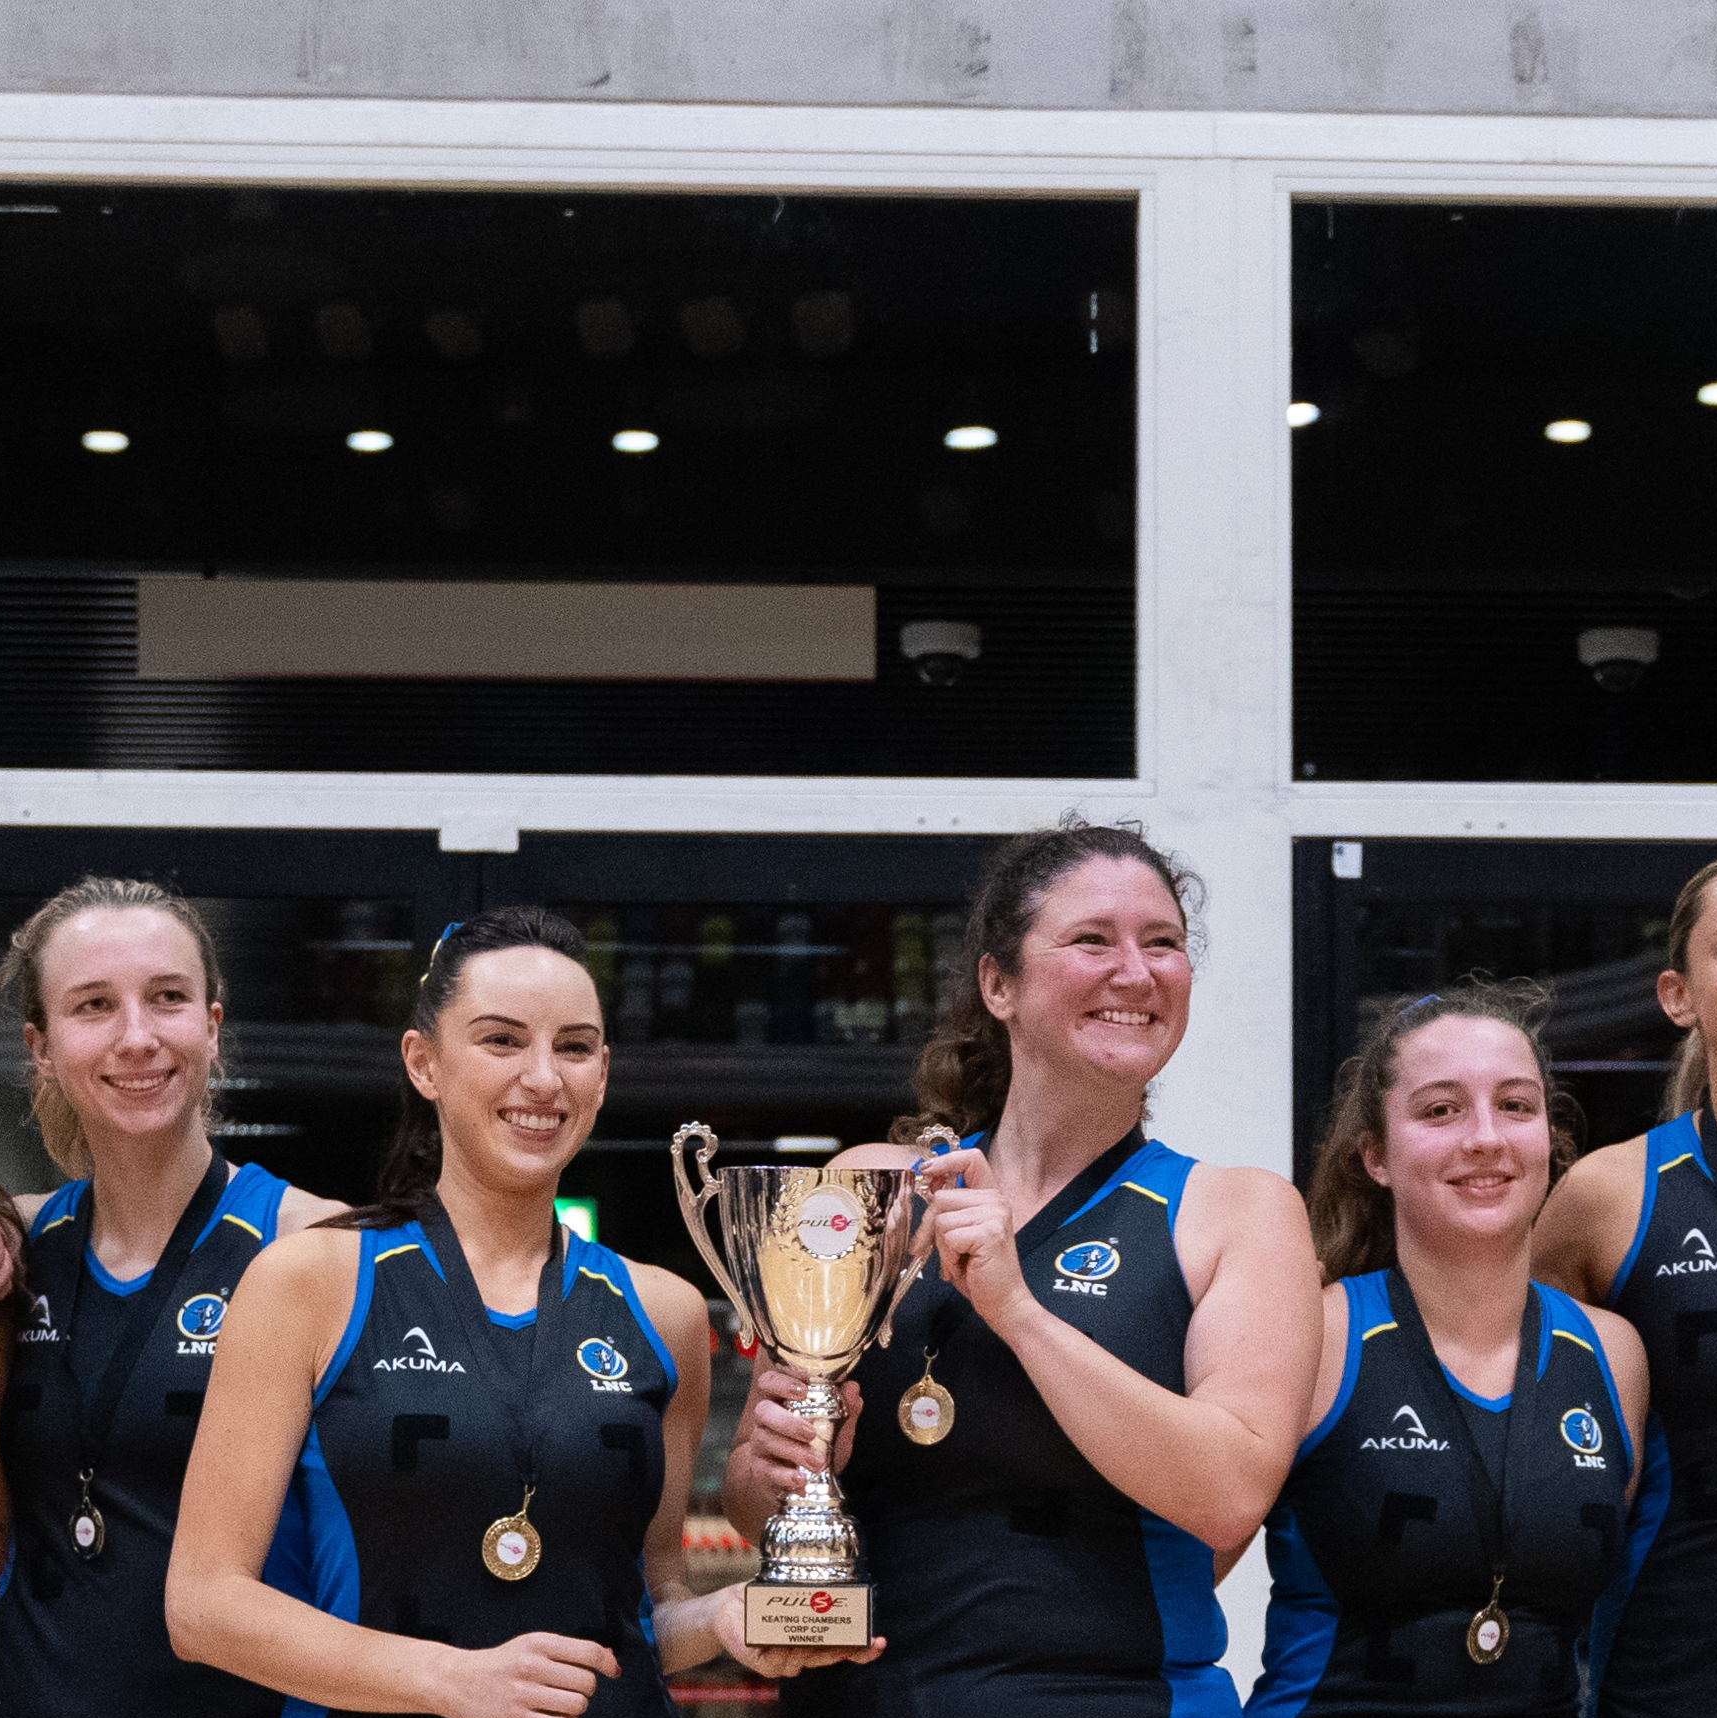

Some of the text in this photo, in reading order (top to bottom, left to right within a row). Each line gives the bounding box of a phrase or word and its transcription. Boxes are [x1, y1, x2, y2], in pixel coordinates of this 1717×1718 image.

[797, 1214, 860, 1232] PULSE
[1053, 1279, 1108, 1296] LNC
[373, 1357, 466, 1375] AKUMA
[590, 1379, 633, 1393] LNC
[1573, 1454, 1607, 1469] LNC
[766, 1590, 848, 1614] PULSE
[761, 1615, 852, 1625] KEATING CHAMBERS
[784, 1625, 830, 1634] CORP CUP
[789, 1635, 824, 1643] WINNER
